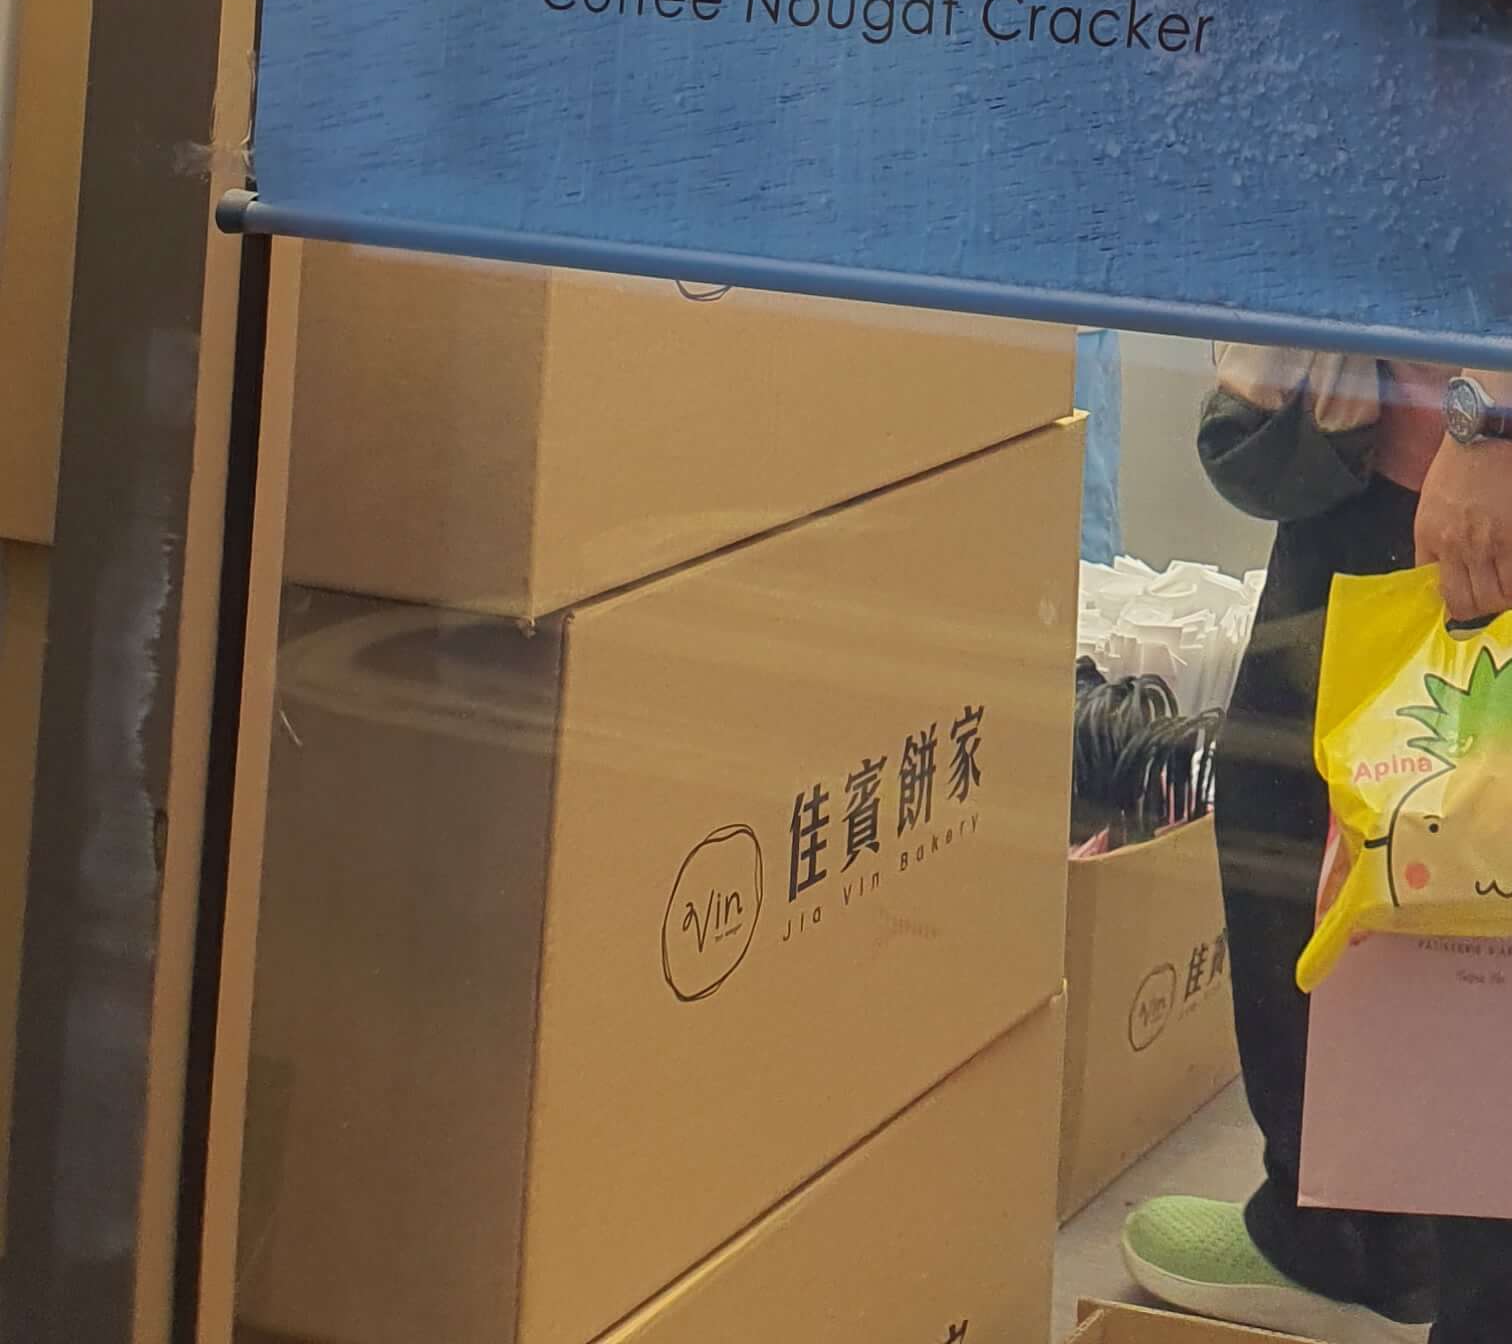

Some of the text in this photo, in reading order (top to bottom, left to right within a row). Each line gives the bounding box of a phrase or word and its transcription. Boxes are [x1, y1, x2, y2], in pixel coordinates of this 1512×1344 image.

[782, 906, 822, 942] Jia
[842, 871, 881, 906] Vin
[899, 812, 979, 873] Bakery
[788, 705, 985, 903] 佳賓餅家
